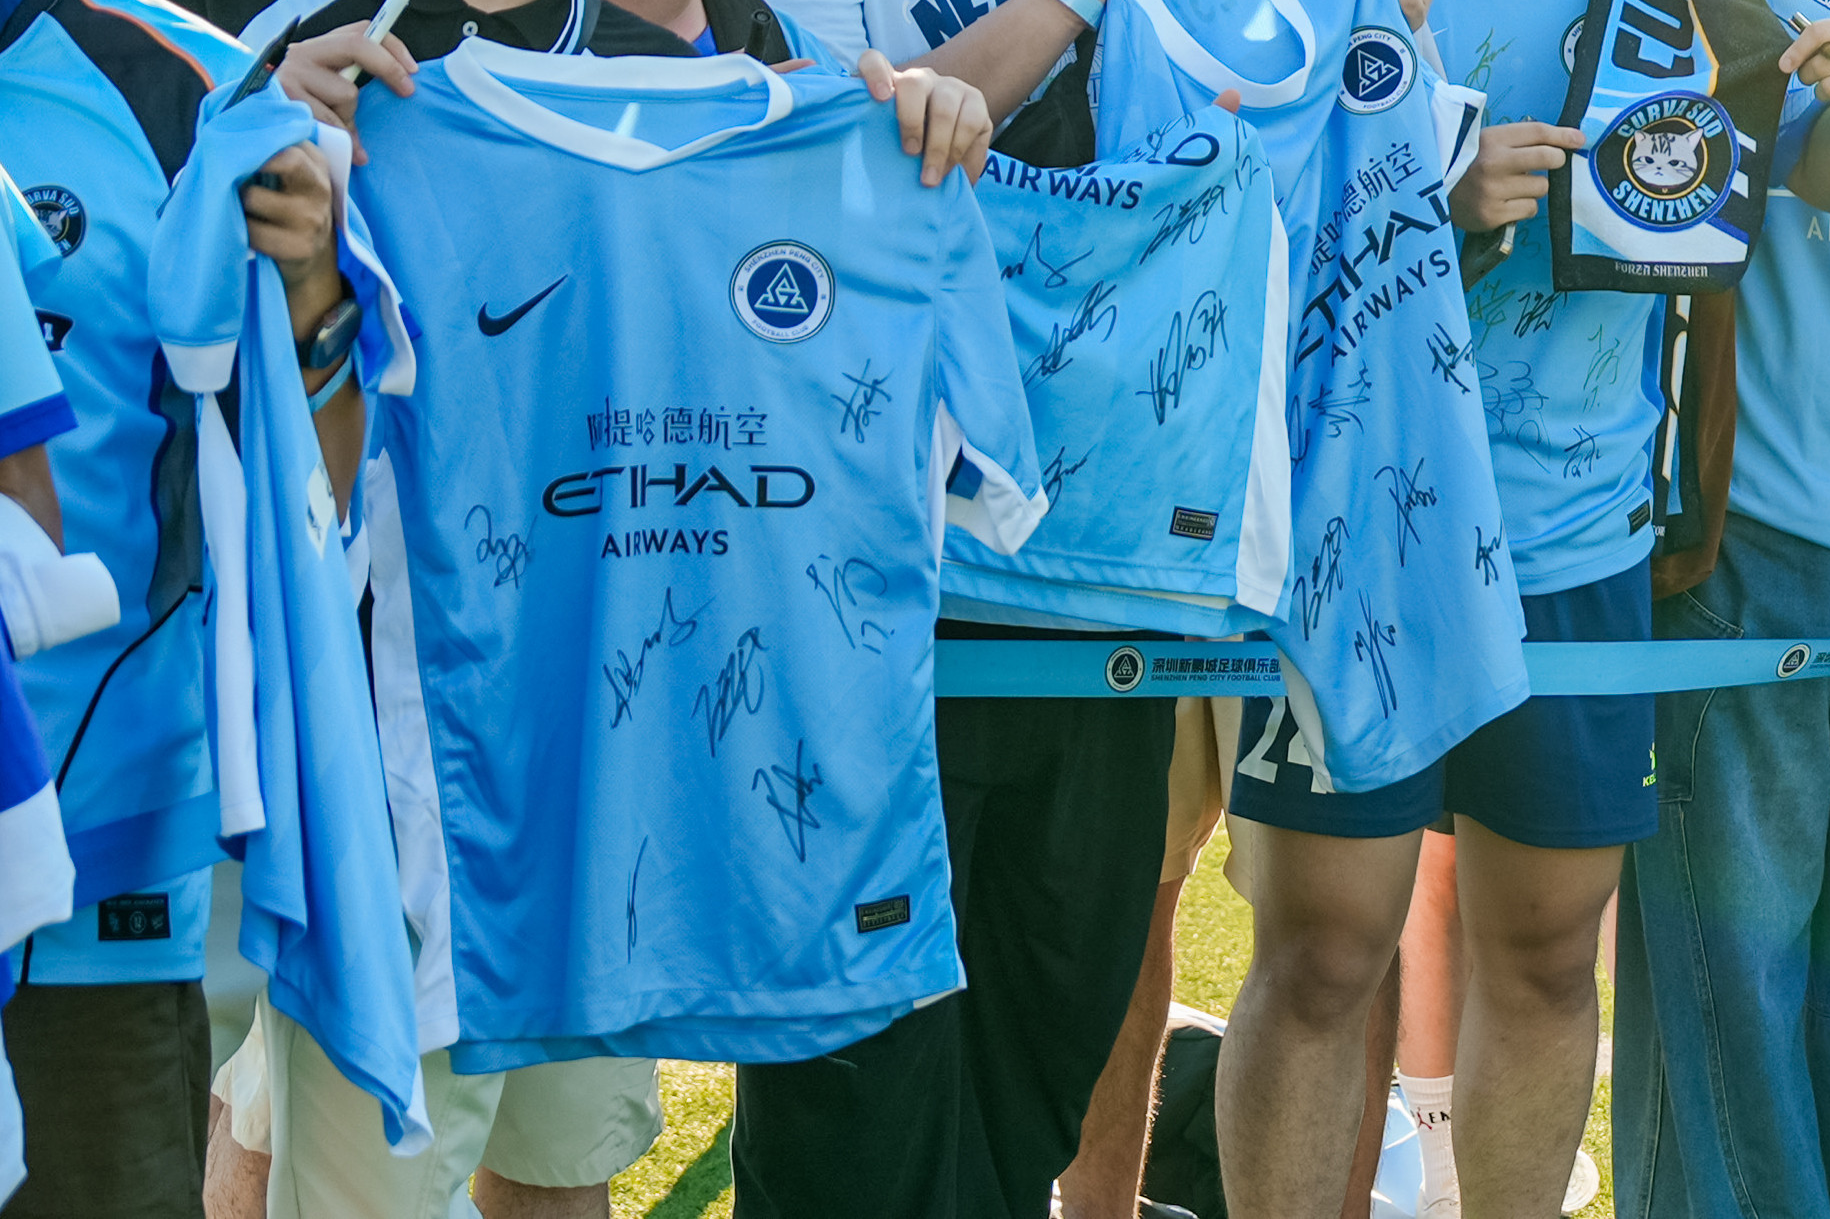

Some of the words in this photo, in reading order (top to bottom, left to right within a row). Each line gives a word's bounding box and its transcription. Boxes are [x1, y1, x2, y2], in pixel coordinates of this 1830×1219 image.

[1617, 99, 1689, 138] CURVA
[1685, 101, 1724, 139] SUD
[980, 153, 1143, 210] AIRWAYS
[1612, 180, 1718, 221] SHENZHEN
[1331, 249, 1452, 368] AIRWAYS
[542, 463, 816, 518] ETIHAD
[601, 528, 729, 558] AIRWAYS
